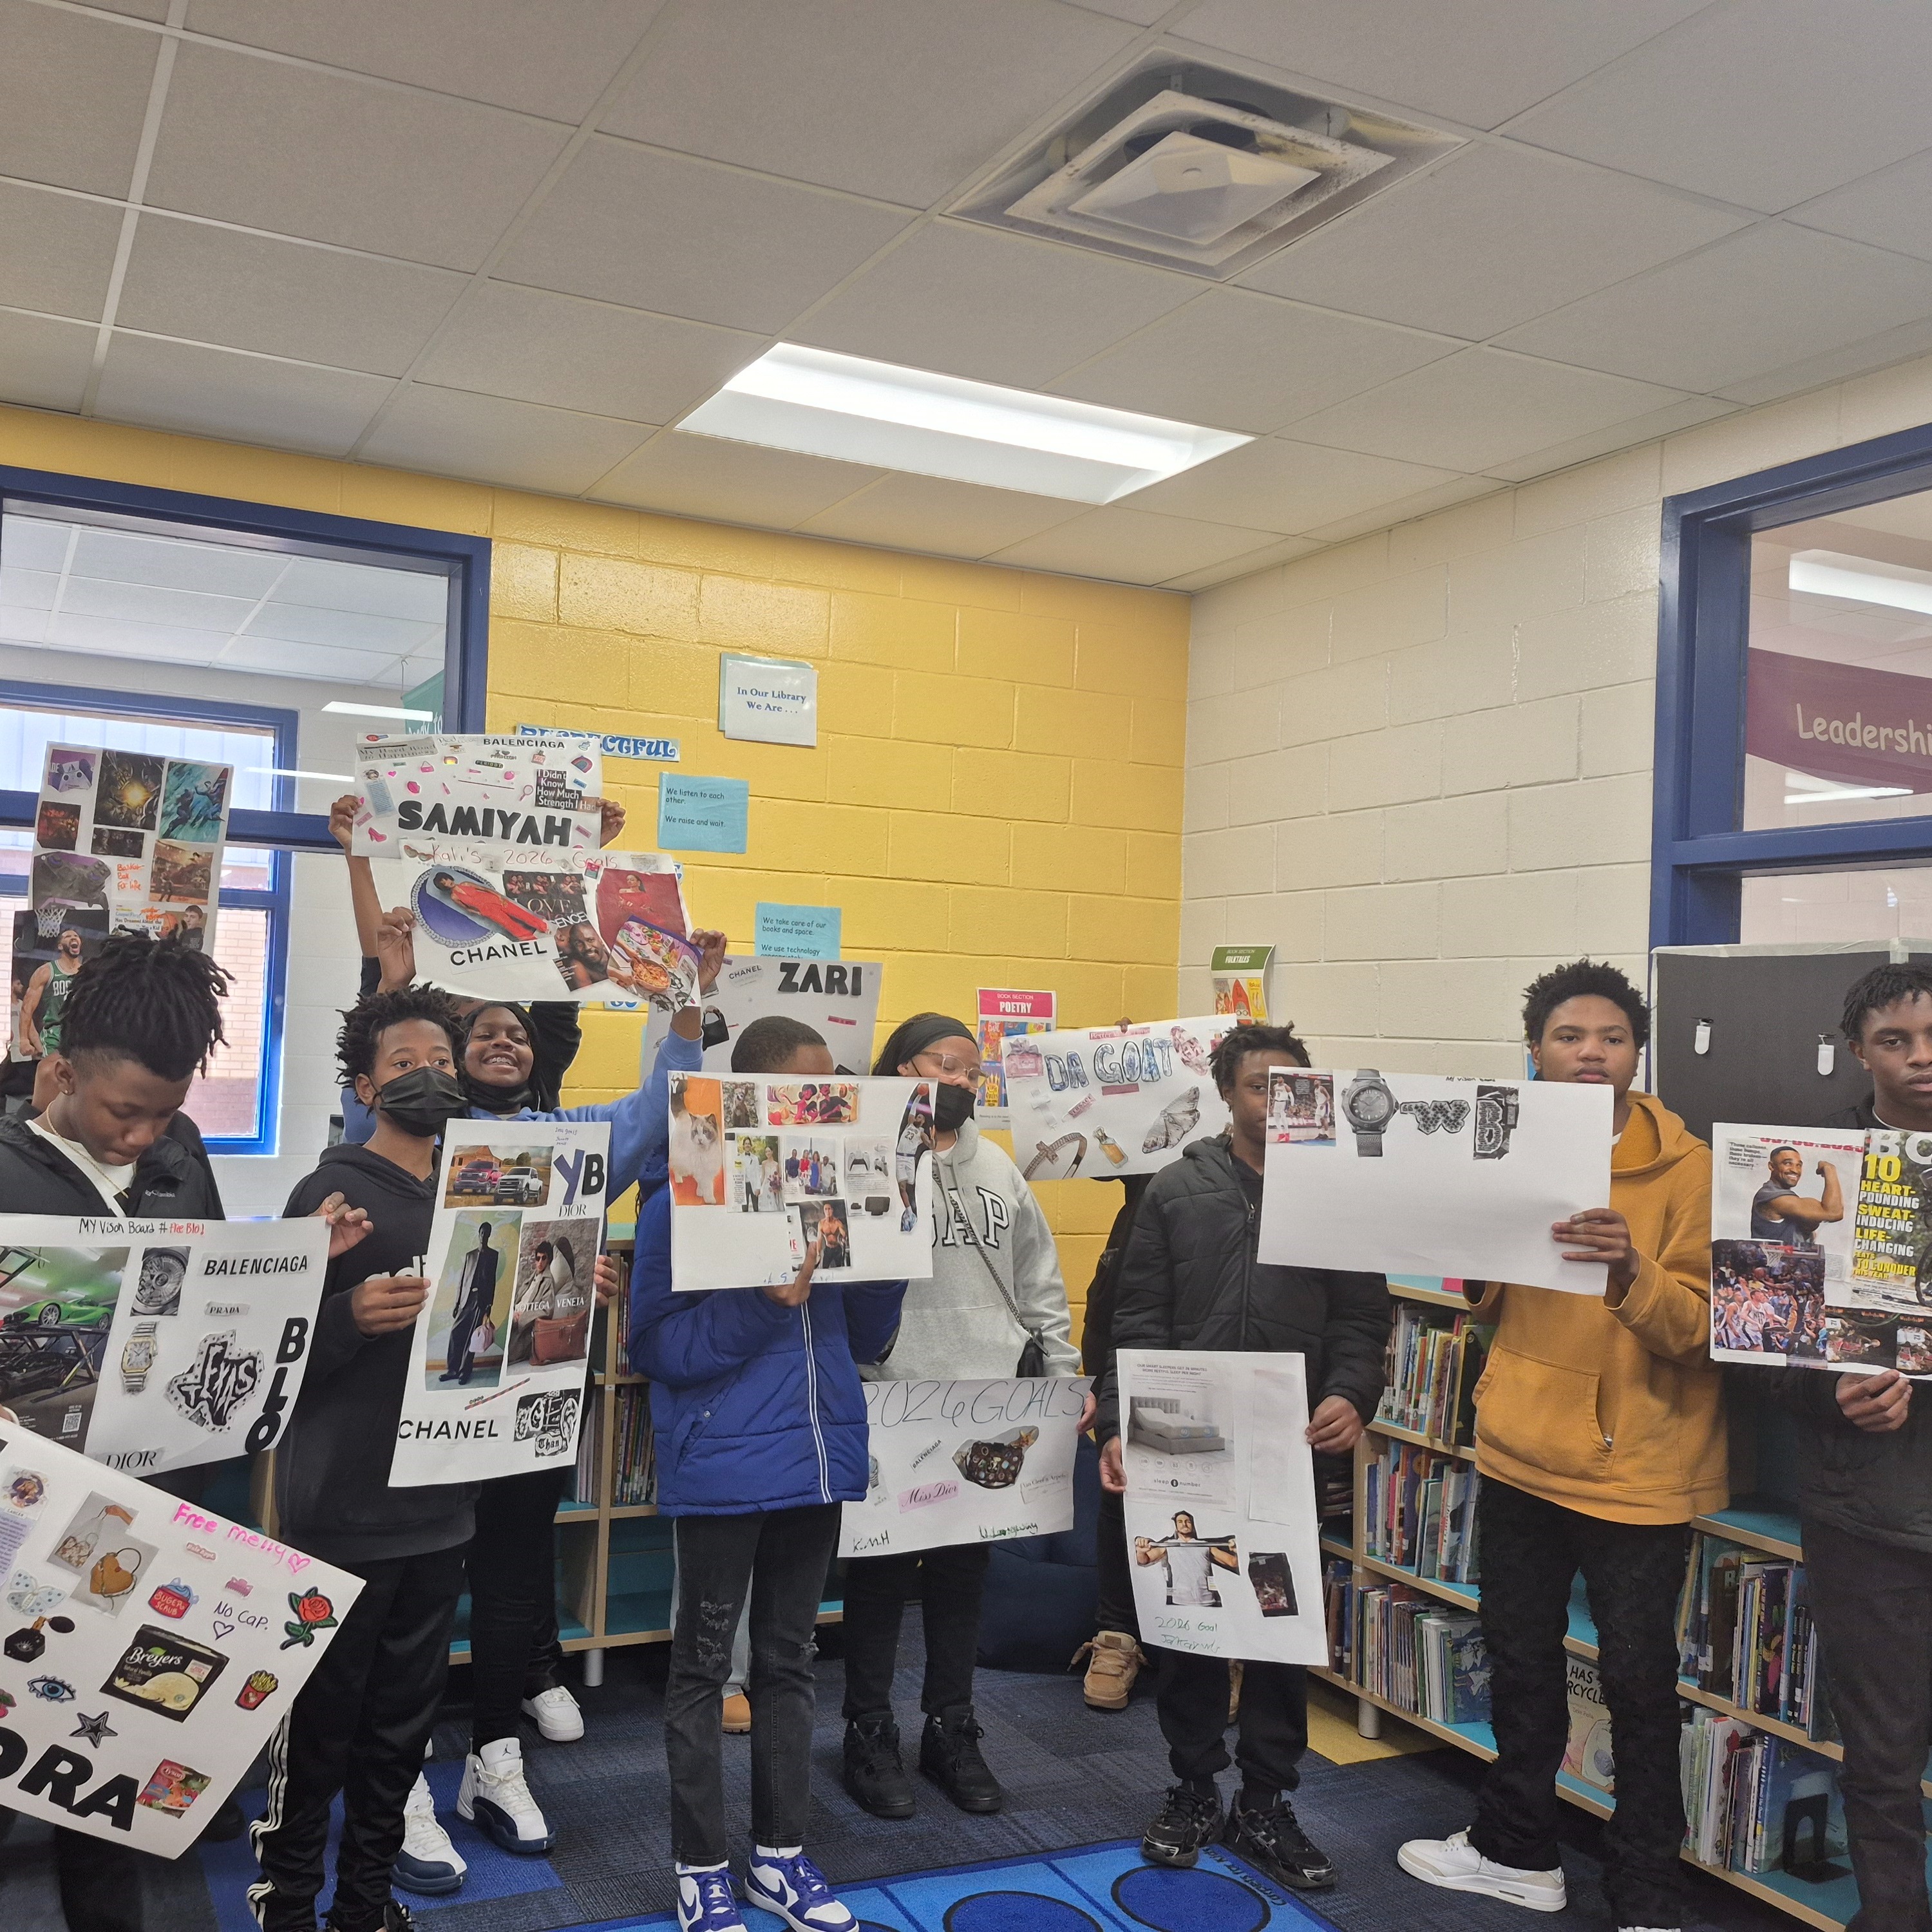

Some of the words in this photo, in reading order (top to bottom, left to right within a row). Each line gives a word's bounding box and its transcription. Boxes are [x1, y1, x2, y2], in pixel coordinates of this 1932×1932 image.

[772, 690, 806, 703] Library
[746, 701, 761, 710] We
[764, 703, 782, 712] Are
[483, 738, 565, 748] BALENCIAGA
[379, 750, 435, 760] Happiness
[543, 770, 567, 779] Didn't
[541, 778, 564, 788] Know
[536, 786, 555, 796] How
[557, 790, 579, 799] Much
[679, 789, 698, 797] listen
[538, 796, 573, 810] Strength
[398, 800, 572, 846] SAMIYAH
[432, 842, 481, 864] Kali's
[504, 850, 553, 866] 2026
[572, 851, 618, 868] Goals
[551, 912, 589, 928] ENCE
[450, 942, 547, 965] CHANEL
[787, 947, 820, 956] technology
[729, 965, 762, 980] CHANEL
[778, 962, 862, 996] ZARI
[999, 1001, 1032, 1013] POETRY
[1045, 1051, 1089, 1091] DA
[1094, 1037, 1173, 1084] GOAT
[905, 1132, 914, 1140] 23
[1864, 1154, 1901, 1182] 10
[553, 1148, 605, 1206] YB
[1861, 1180, 1917, 1196] HEART-
[1859, 1191, 1919, 1209] POUNDING
[558, 1204, 587, 1217] DIOR
[932, 1186, 1009, 1249] AP
[1858, 1204, 1916, 1220] SWEAT-
[100, 1220, 124, 1234] Vison
[128, 1221, 155, 1234] Board
[1856, 1215, 1913, 1233] INDUCING
[1855, 1227, 1892, 1242] LIFE-
[1855, 1238, 1914, 1257] CHANGING
[204, 1255, 308, 1276] BALENCIAGA
[1857, 1258, 1870, 1269] TO
[1871, 1260, 1917, 1276] CONQUER
[1870, 1271, 1889, 1280] YEAR
[209, 1306, 240, 1314] PRADA
[515, 1301, 550, 1312] BOTTEGA
[556, 1297, 585, 1308] VENETA
[862, 1379, 965, 1427] 2026
[971, 1379, 1093, 1423] GOALS
[398, 1419, 498, 1439] CHANEL
[106, 1450, 157, 1470] DIOR
[913, 1439, 942, 1469] BALENCIAGA
[902, 1488, 931, 1507] Miss
[933, 1482, 957, 1499] Dior
[173, 1503, 218, 1533] Free
[1198, 1622, 1217, 1632] Goal
[125, 1647, 184, 1668] Breyers
[1570, 1665, 1593, 1684] HAS
